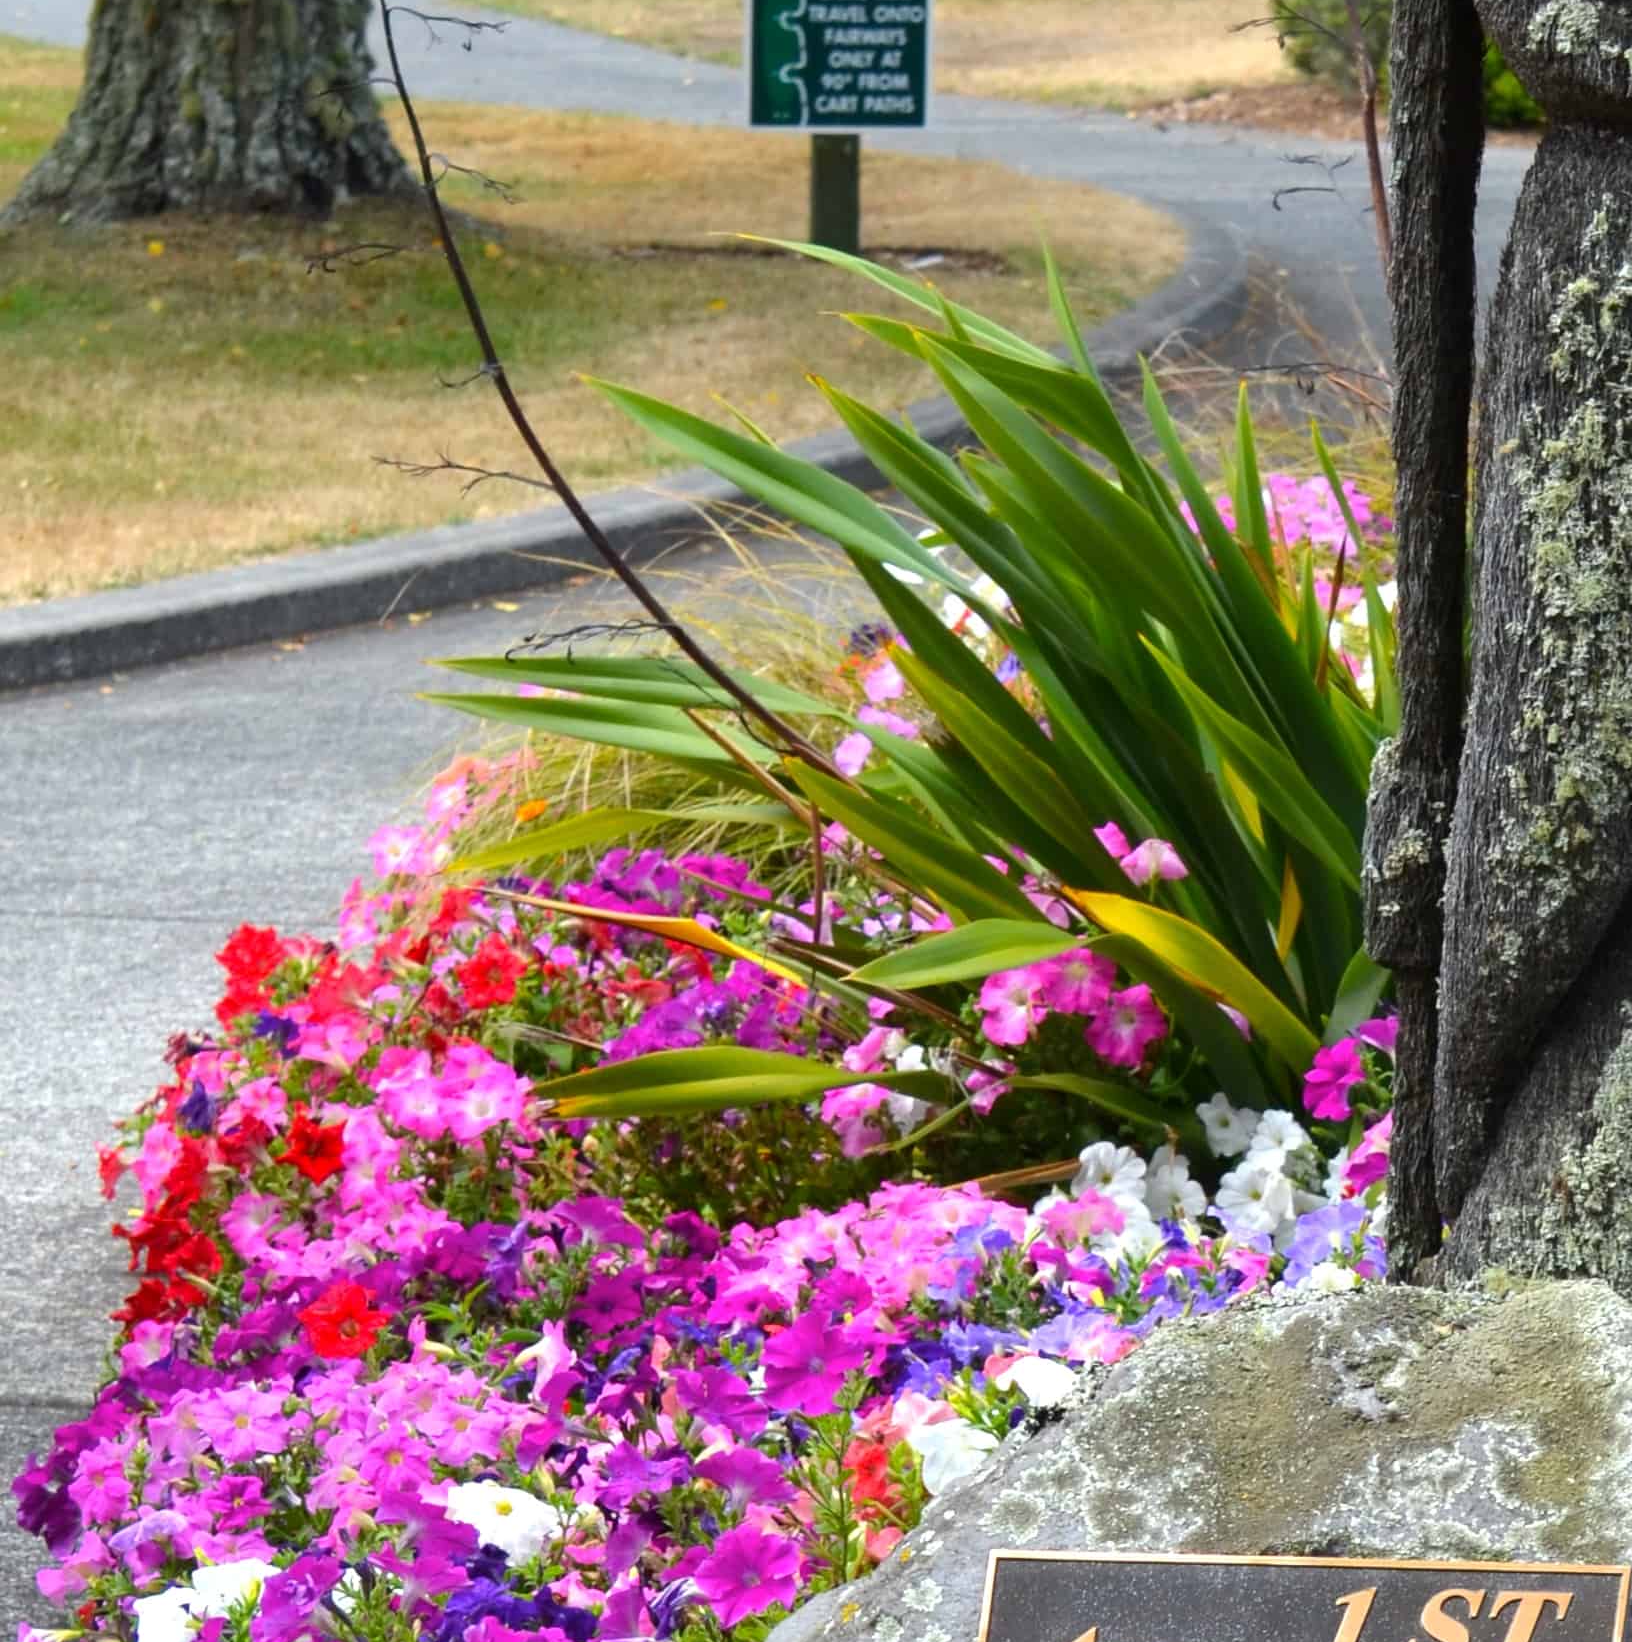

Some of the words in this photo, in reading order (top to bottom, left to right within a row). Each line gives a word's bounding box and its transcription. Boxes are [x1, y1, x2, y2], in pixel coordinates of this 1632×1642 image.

[809, 6, 868, 22] TRAVEL
[874, 6, 924, 23] ONTO
[824, 28, 906, 44] FAIRWAYS
[828, 51, 874, 67] ONLY
[880, 51, 902, 67] AT
[821, 74, 853, 89] 90°
[858, 74, 909, 90] FROM
[815, 96, 858, 112] CART
[863, 97, 914, 113] PATHS
